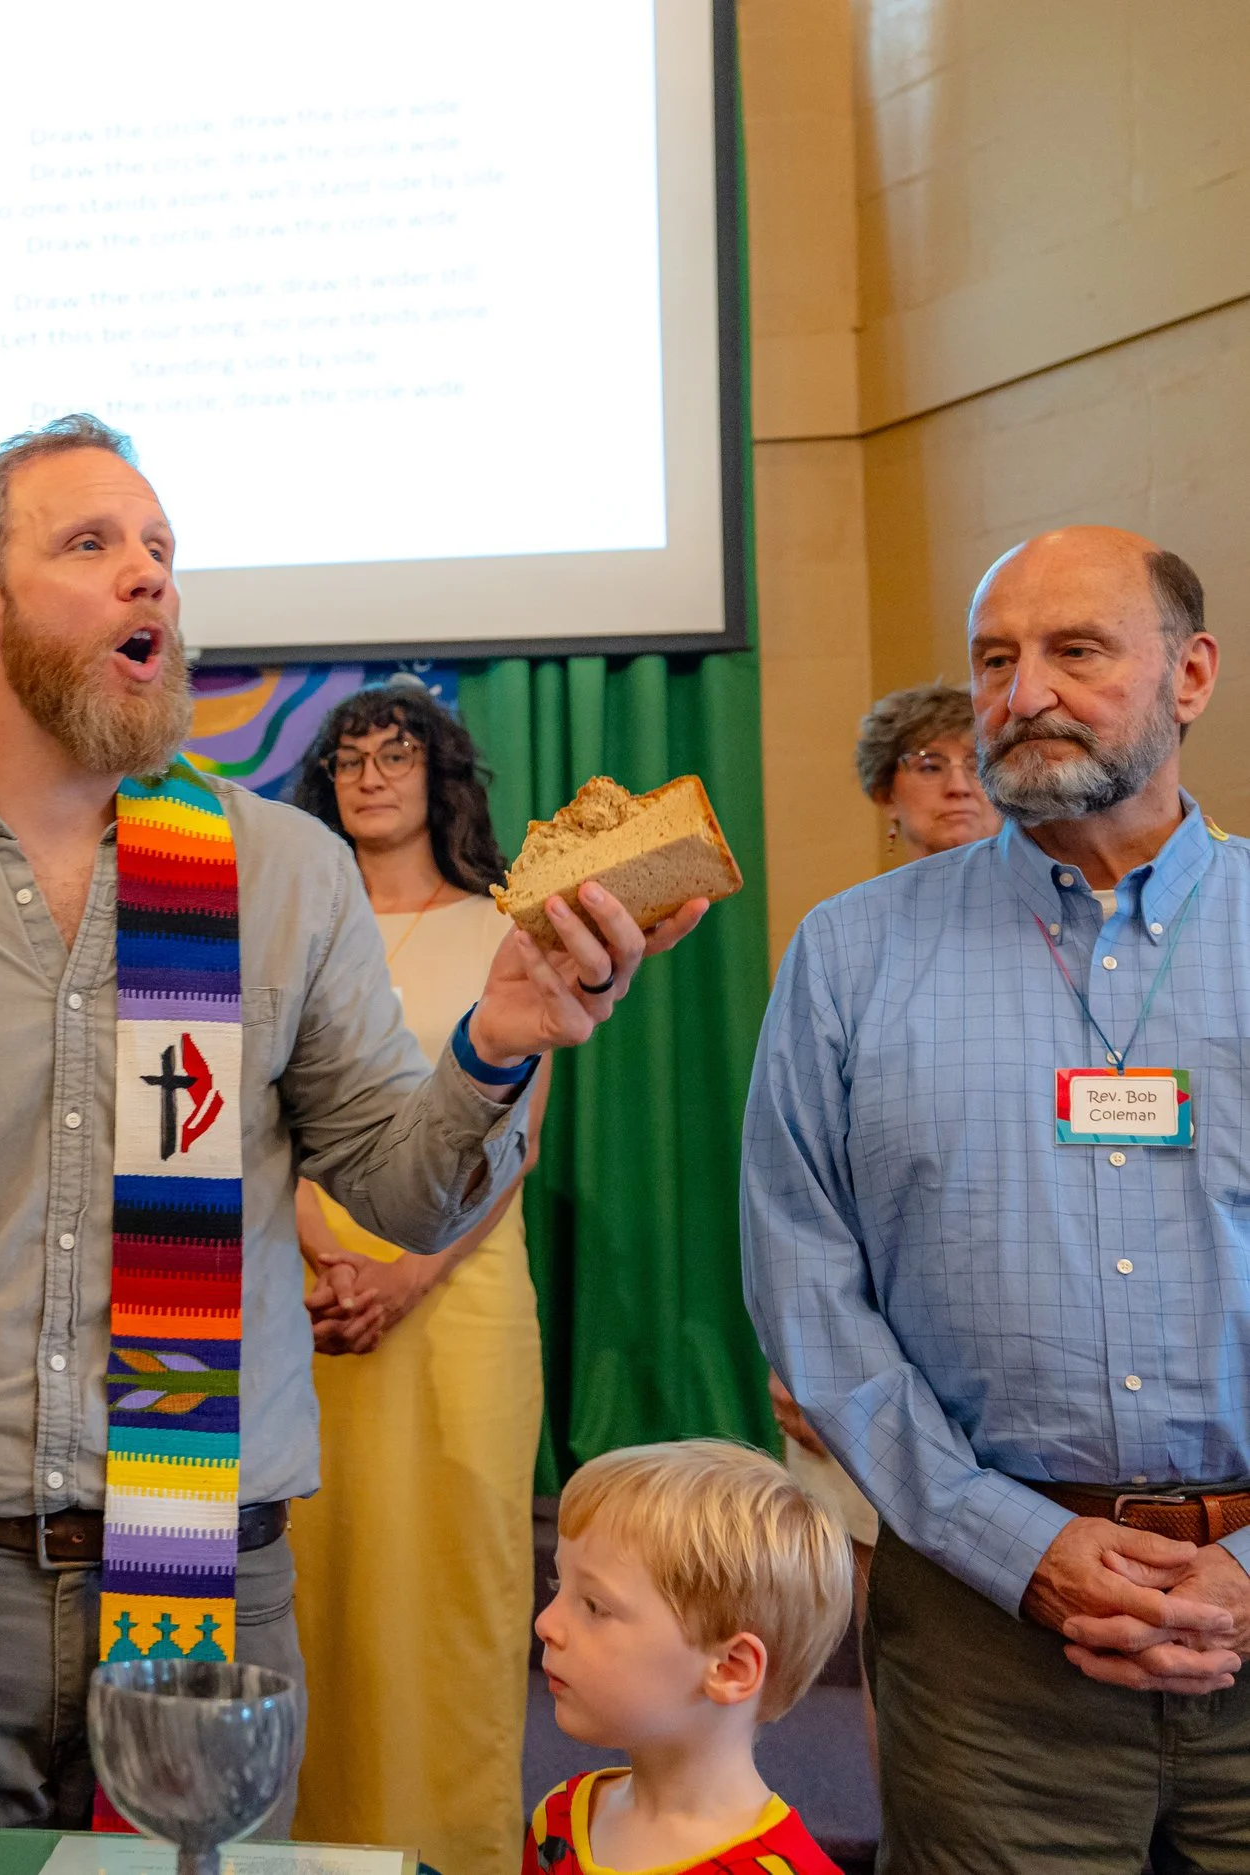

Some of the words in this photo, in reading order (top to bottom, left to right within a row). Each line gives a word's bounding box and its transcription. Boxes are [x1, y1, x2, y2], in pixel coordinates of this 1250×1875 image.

[1086, 1090, 1121, 1104] Rev.
[1125, 1090, 1157, 1104] Bob
[1089, 1108, 1157, 1122] Coleman
